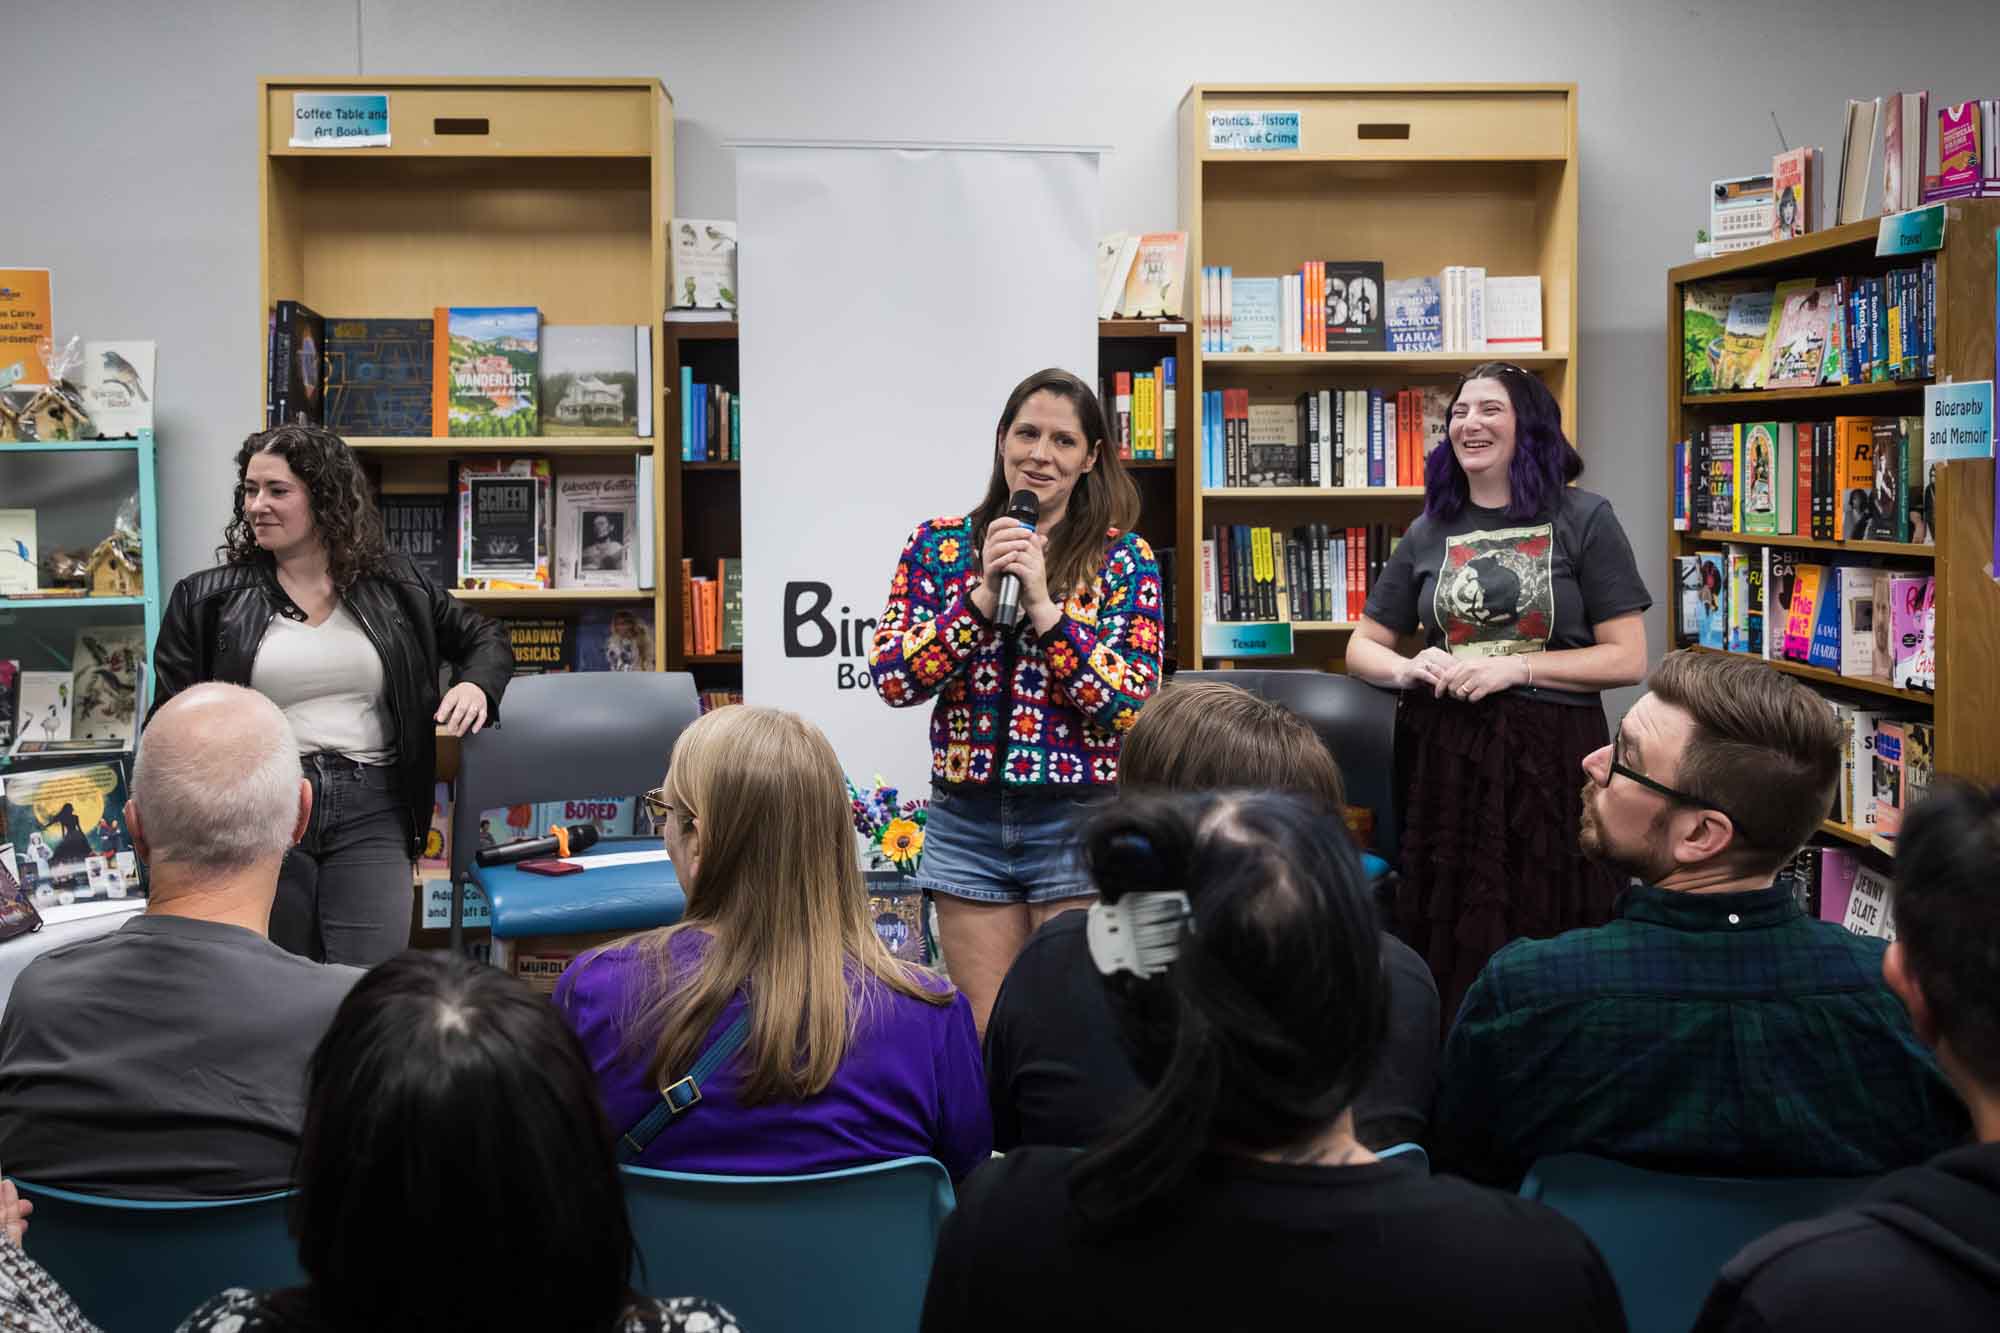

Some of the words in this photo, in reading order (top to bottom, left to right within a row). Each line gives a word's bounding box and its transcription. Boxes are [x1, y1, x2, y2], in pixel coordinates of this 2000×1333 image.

[296, 109, 332, 120] Coffee
[336, 108, 364, 120] Table
[368, 109, 388, 120] and
[314, 127, 333, 137] Art
[336, 126, 370, 137] Books
[1265, 132, 1297, 144] Crime
[1900, 232, 1921, 247] Travel
[1391, 296, 1423, 305] STND
[1871, 296, 1879, 322] South
[1390, 317, 1440, 327] DICTATOR
[1858, 298, 1868, 344] Mexico
[1393, 331, 1435, 343] MARIA
[1871, 322, 1879, 358] America
[1396, 343, 1433, 352] RESSA
[455, 373, 532, 387] WANDERLUST
[1935, 397, 1983, 417] Biography
[1431, 424, 1448, 434] PA
[1930, 427, 1947, 445] and
[1950, 426, 1988, 445] Memoir
[479, 486, 528, 512] SCREEN
[1749, 570, 1762, 586] FU
[1773, 565, 1793, 577] GA
[784, 581, 877, 658] Bir
[511, 628, 564, 644] ROADWAY
[1817, 624, 1837, 639] KAMA
[1232, 639, 1267, 649] Texana
[1812, 643, 1838, 660] HARRI
[512, 647, 560, 662] USICALS
[837, 663, 871, 690] Bo
[565, 801, 617, 820] BORED
[464, 889, 481, 900] Co
[1856, 873, 1884, 903] JENNY
[427, 908, 447, 918] and
[464, 907, 477, 918] aft
[1851, 897, 1878, 925] SLATE
